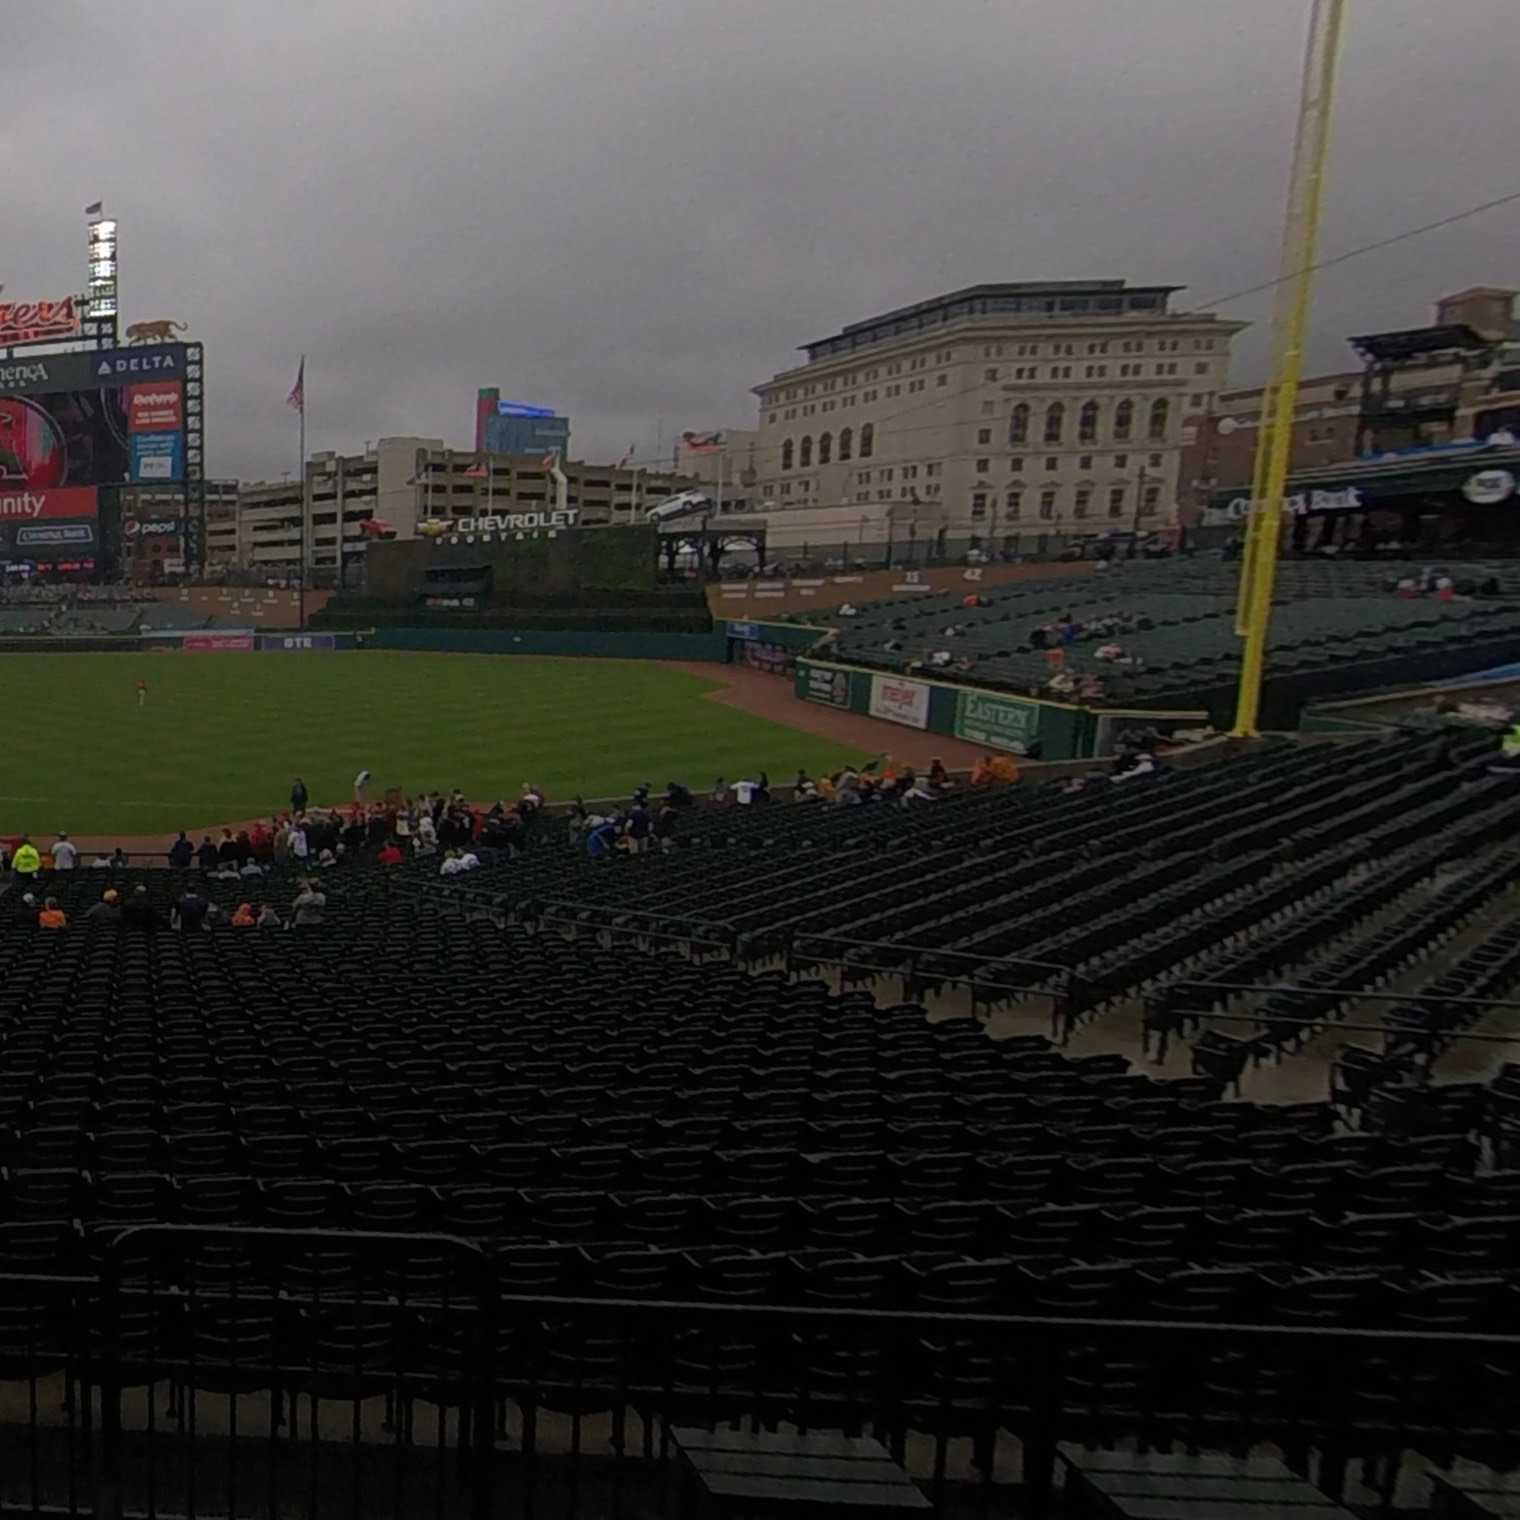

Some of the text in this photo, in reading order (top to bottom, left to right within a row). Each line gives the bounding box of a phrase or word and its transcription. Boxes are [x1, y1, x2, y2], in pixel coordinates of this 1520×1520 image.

[116, 355, 175, 371] DELTA
[141, 520, 175, 534] pepsi
[458, 509, 579, 532] CHEVROLET
